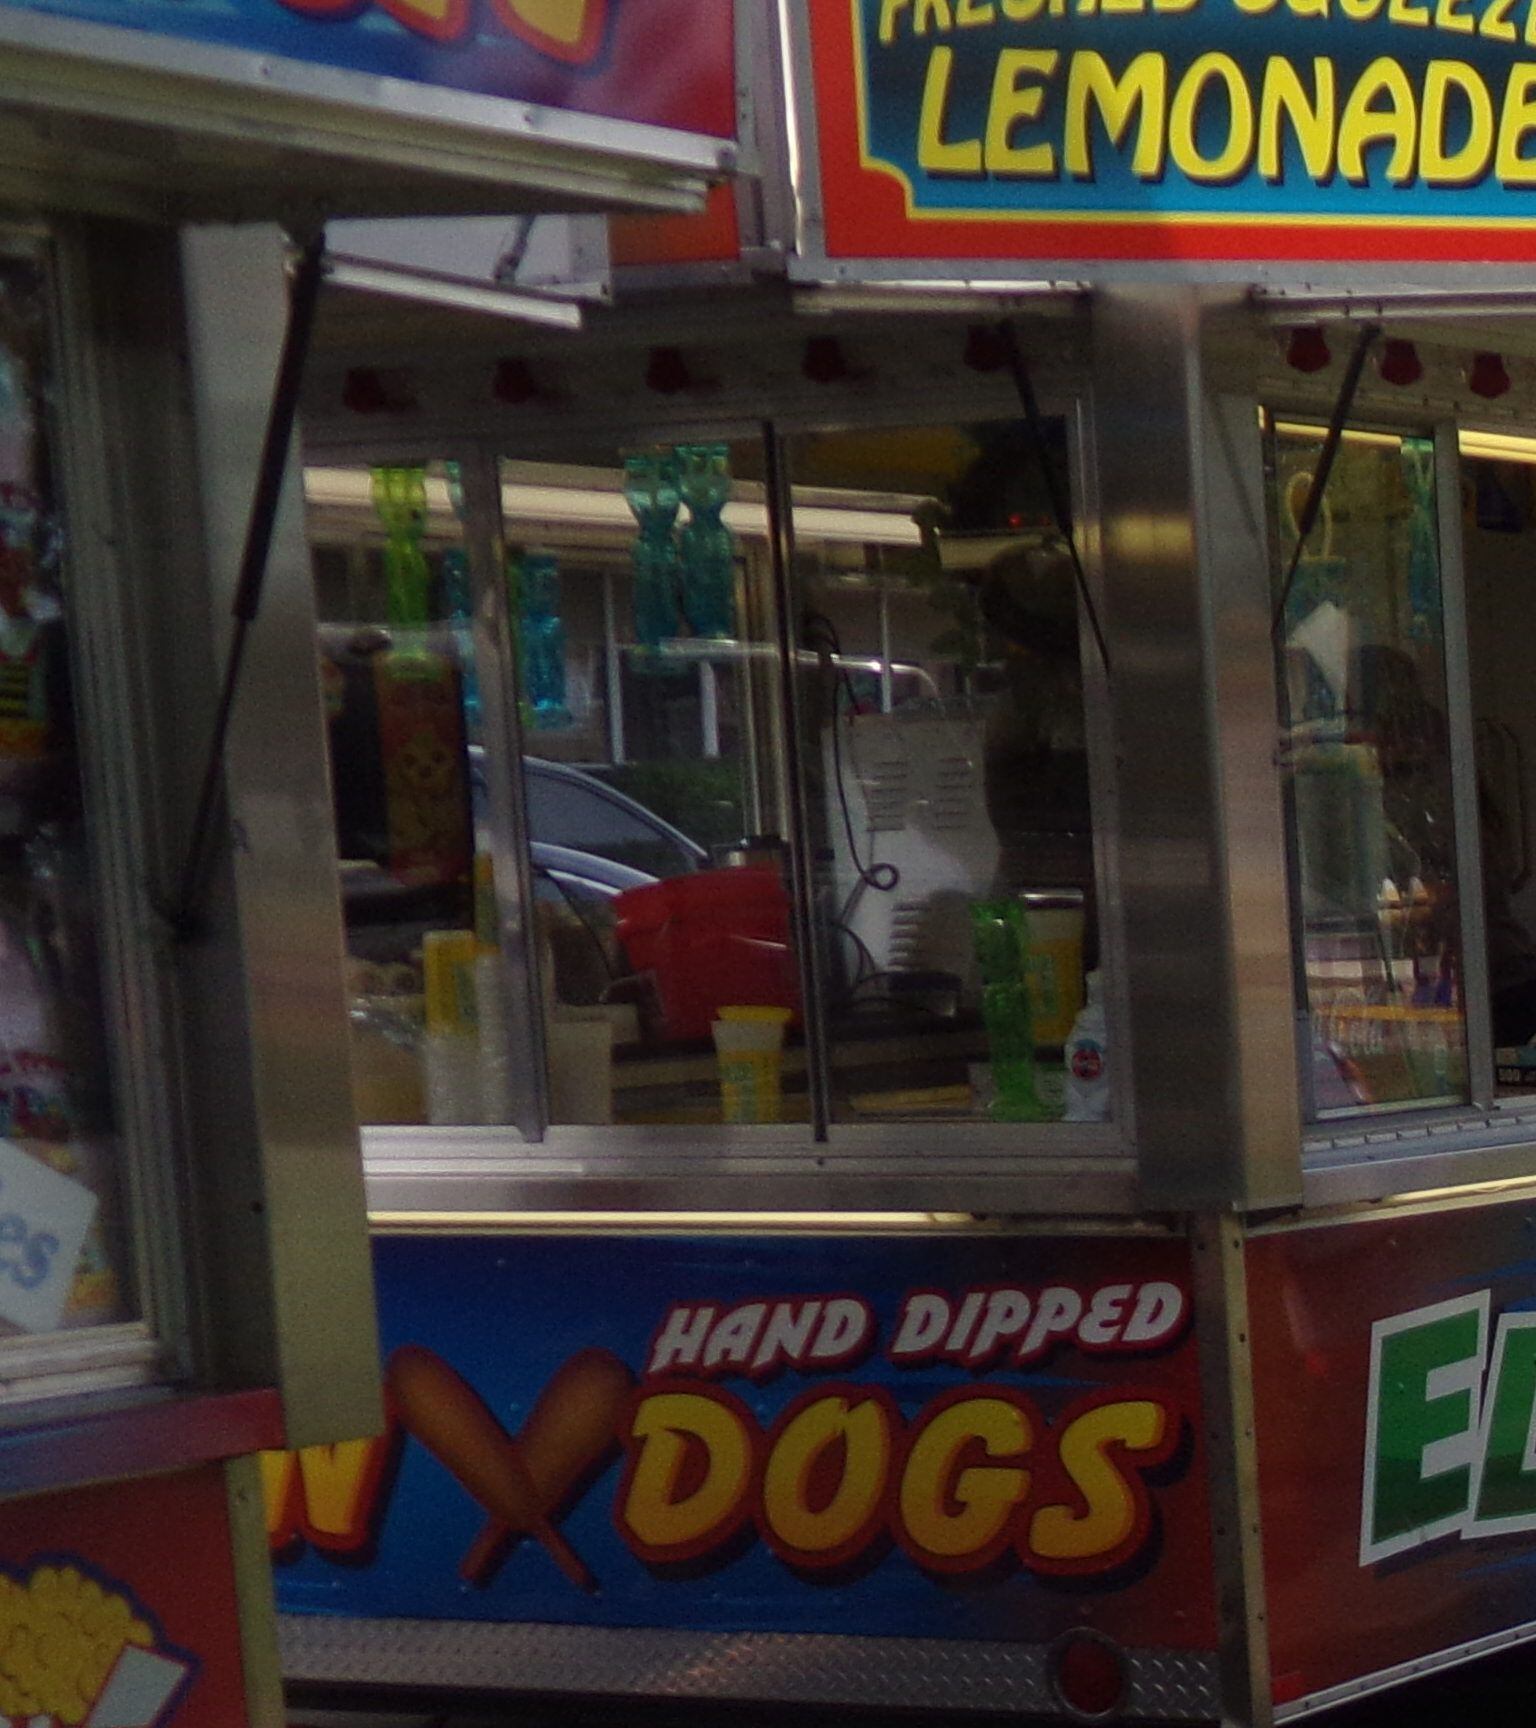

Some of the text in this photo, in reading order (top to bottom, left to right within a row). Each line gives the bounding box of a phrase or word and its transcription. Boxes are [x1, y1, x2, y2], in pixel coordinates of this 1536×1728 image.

[651, 1281, 1184, 1372] HAND DIPPED
[624, 1393, 1166, 1562] DOGS
